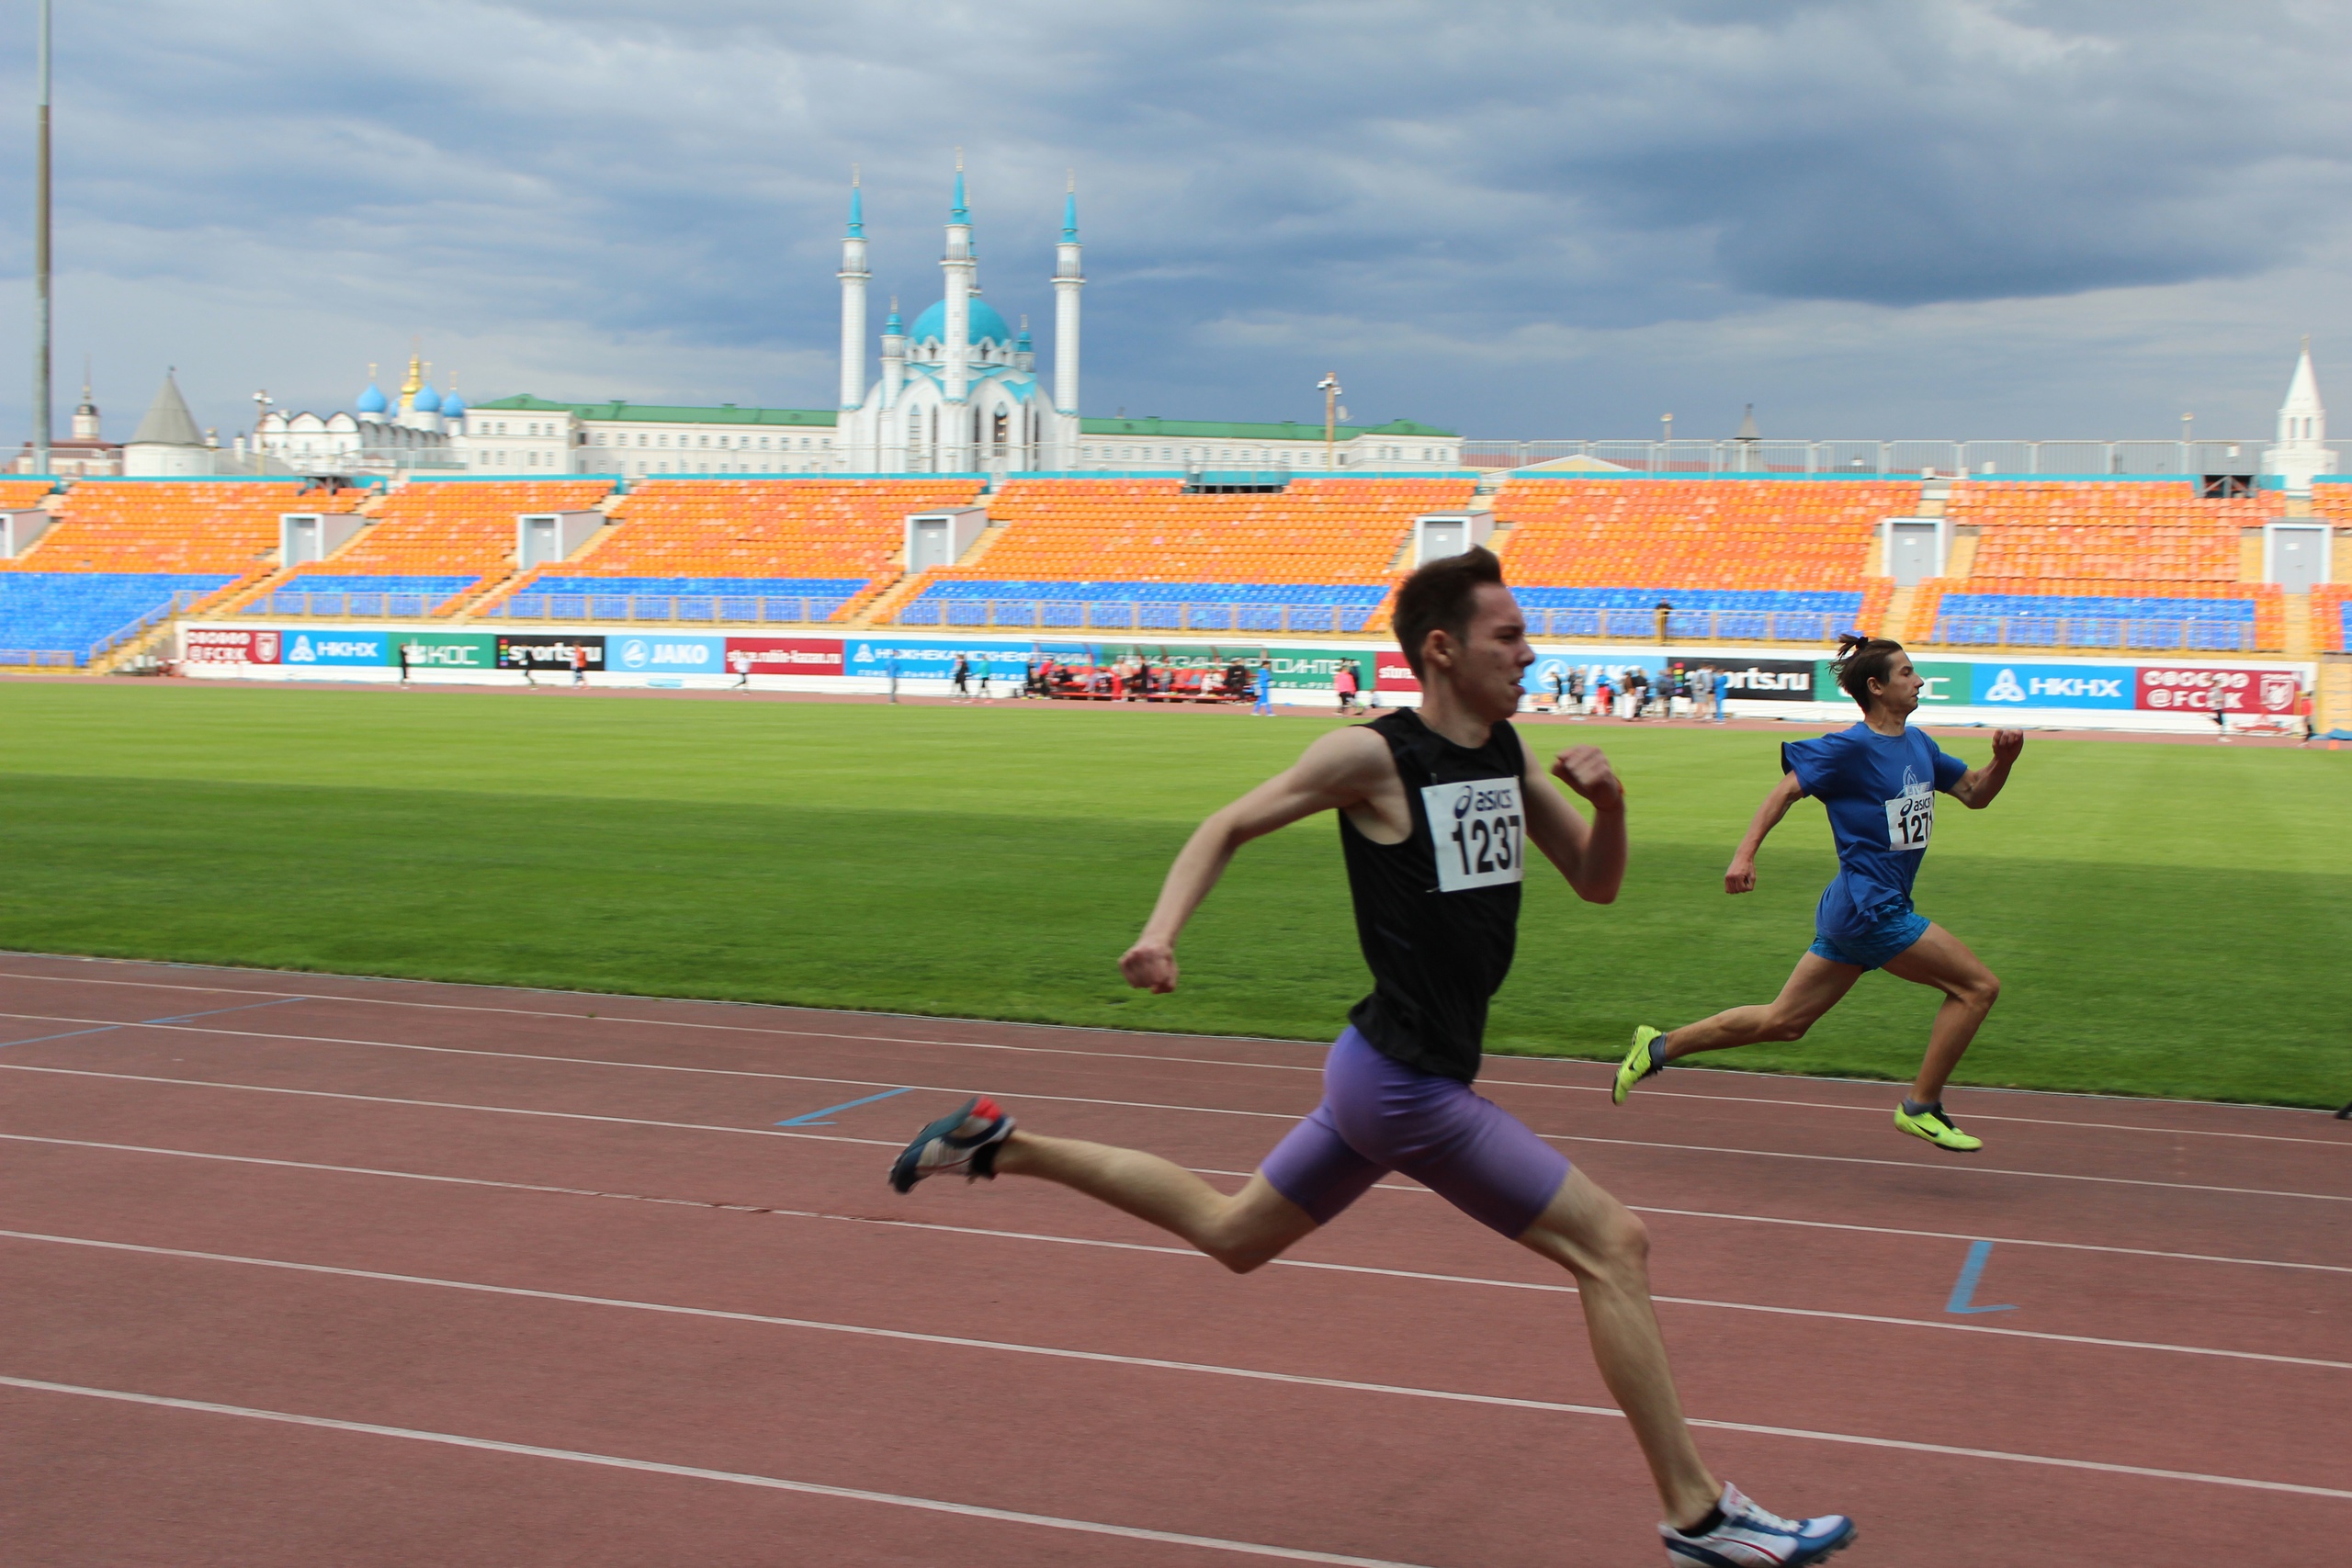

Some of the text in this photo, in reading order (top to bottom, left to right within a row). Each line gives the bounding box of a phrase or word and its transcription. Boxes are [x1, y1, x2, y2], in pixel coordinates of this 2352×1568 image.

[650, 644, 709, 664] JAKO
[2030, 677, 2122, 698] НКНХ
[2146, 689, 2245, 709] @FCK
[1475, 789, 1512, 811] asics
[1914, 797, 1930, 811] asics
